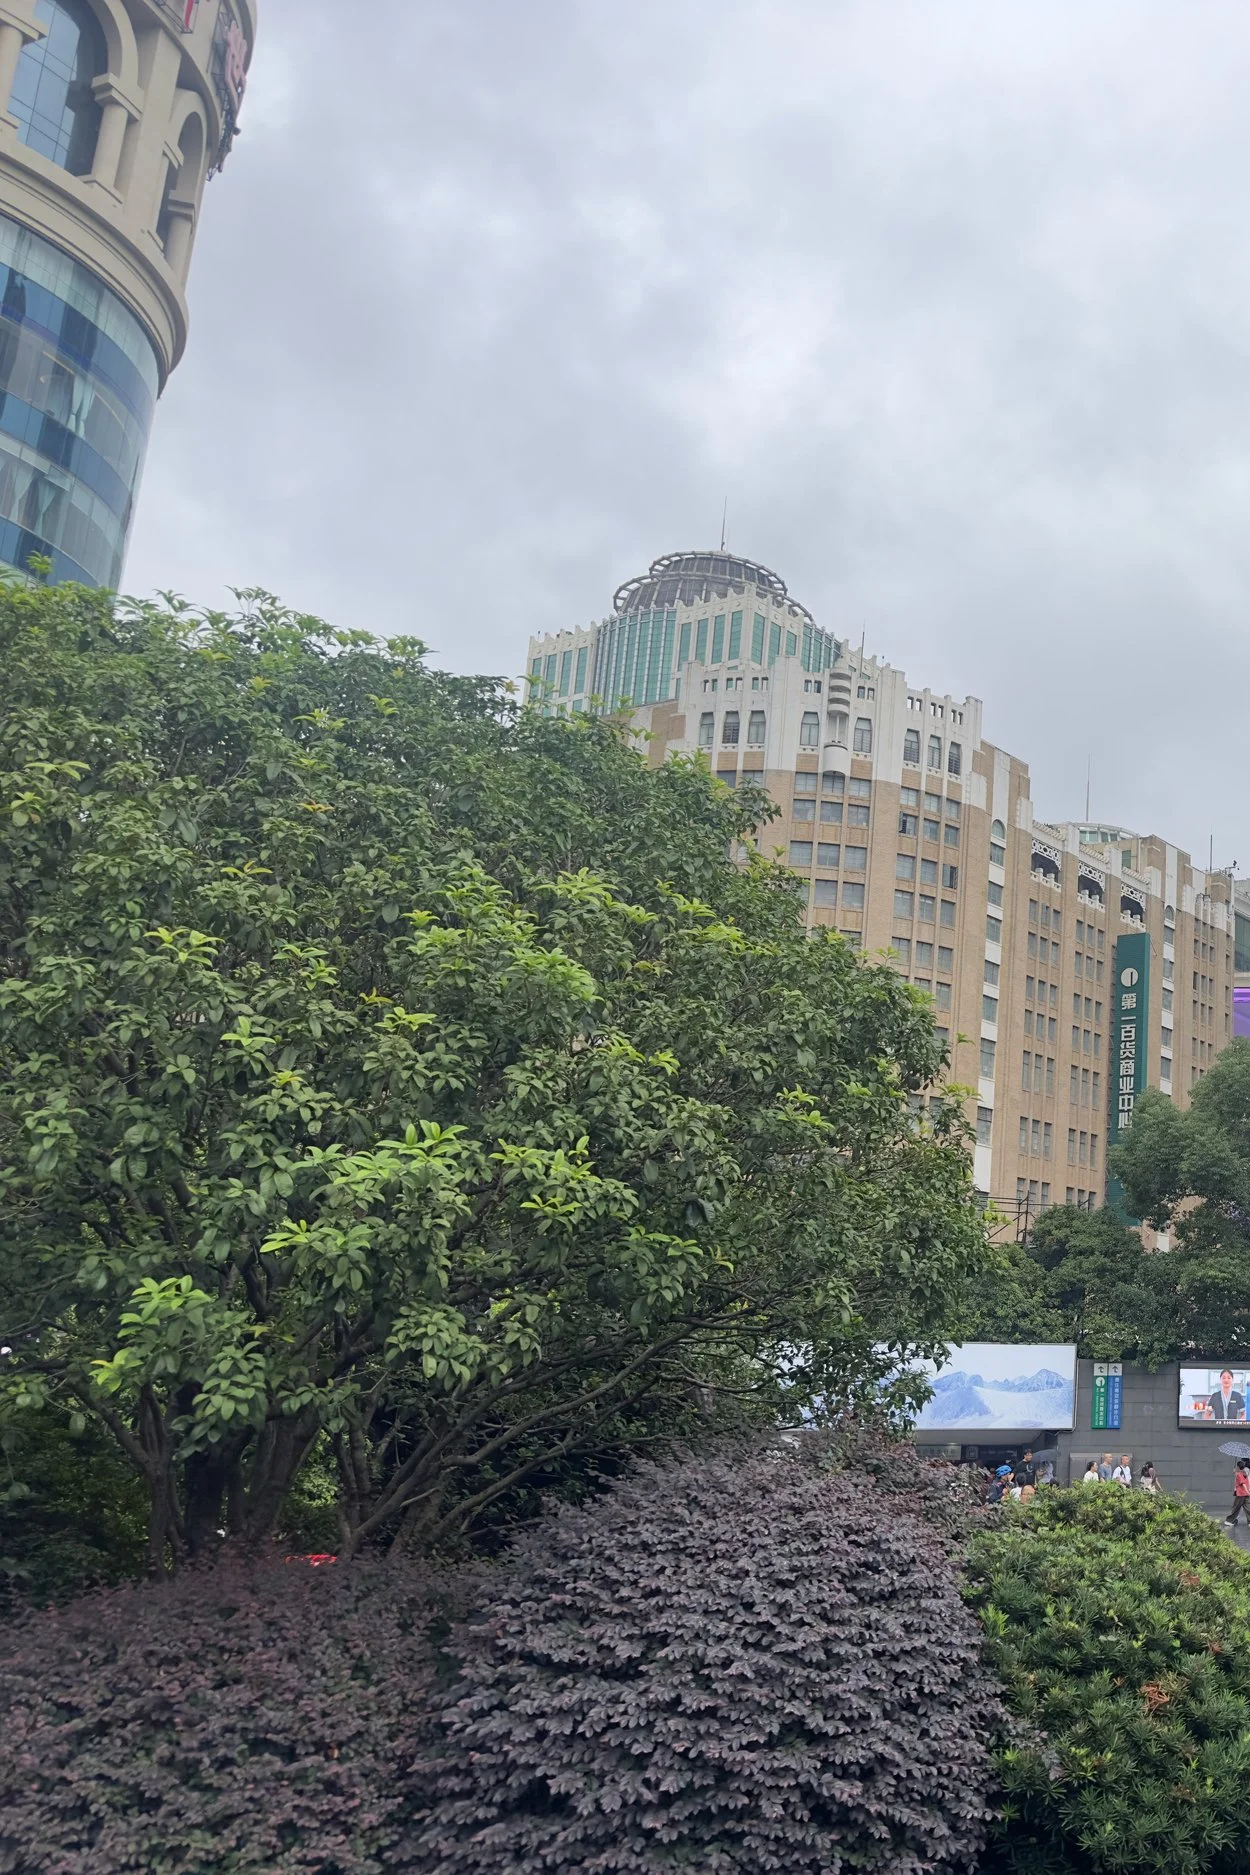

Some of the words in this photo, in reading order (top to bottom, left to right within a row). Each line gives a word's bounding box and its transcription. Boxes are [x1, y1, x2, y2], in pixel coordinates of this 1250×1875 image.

[1118, 993, 1137, 1129] 第一百货商业中心
